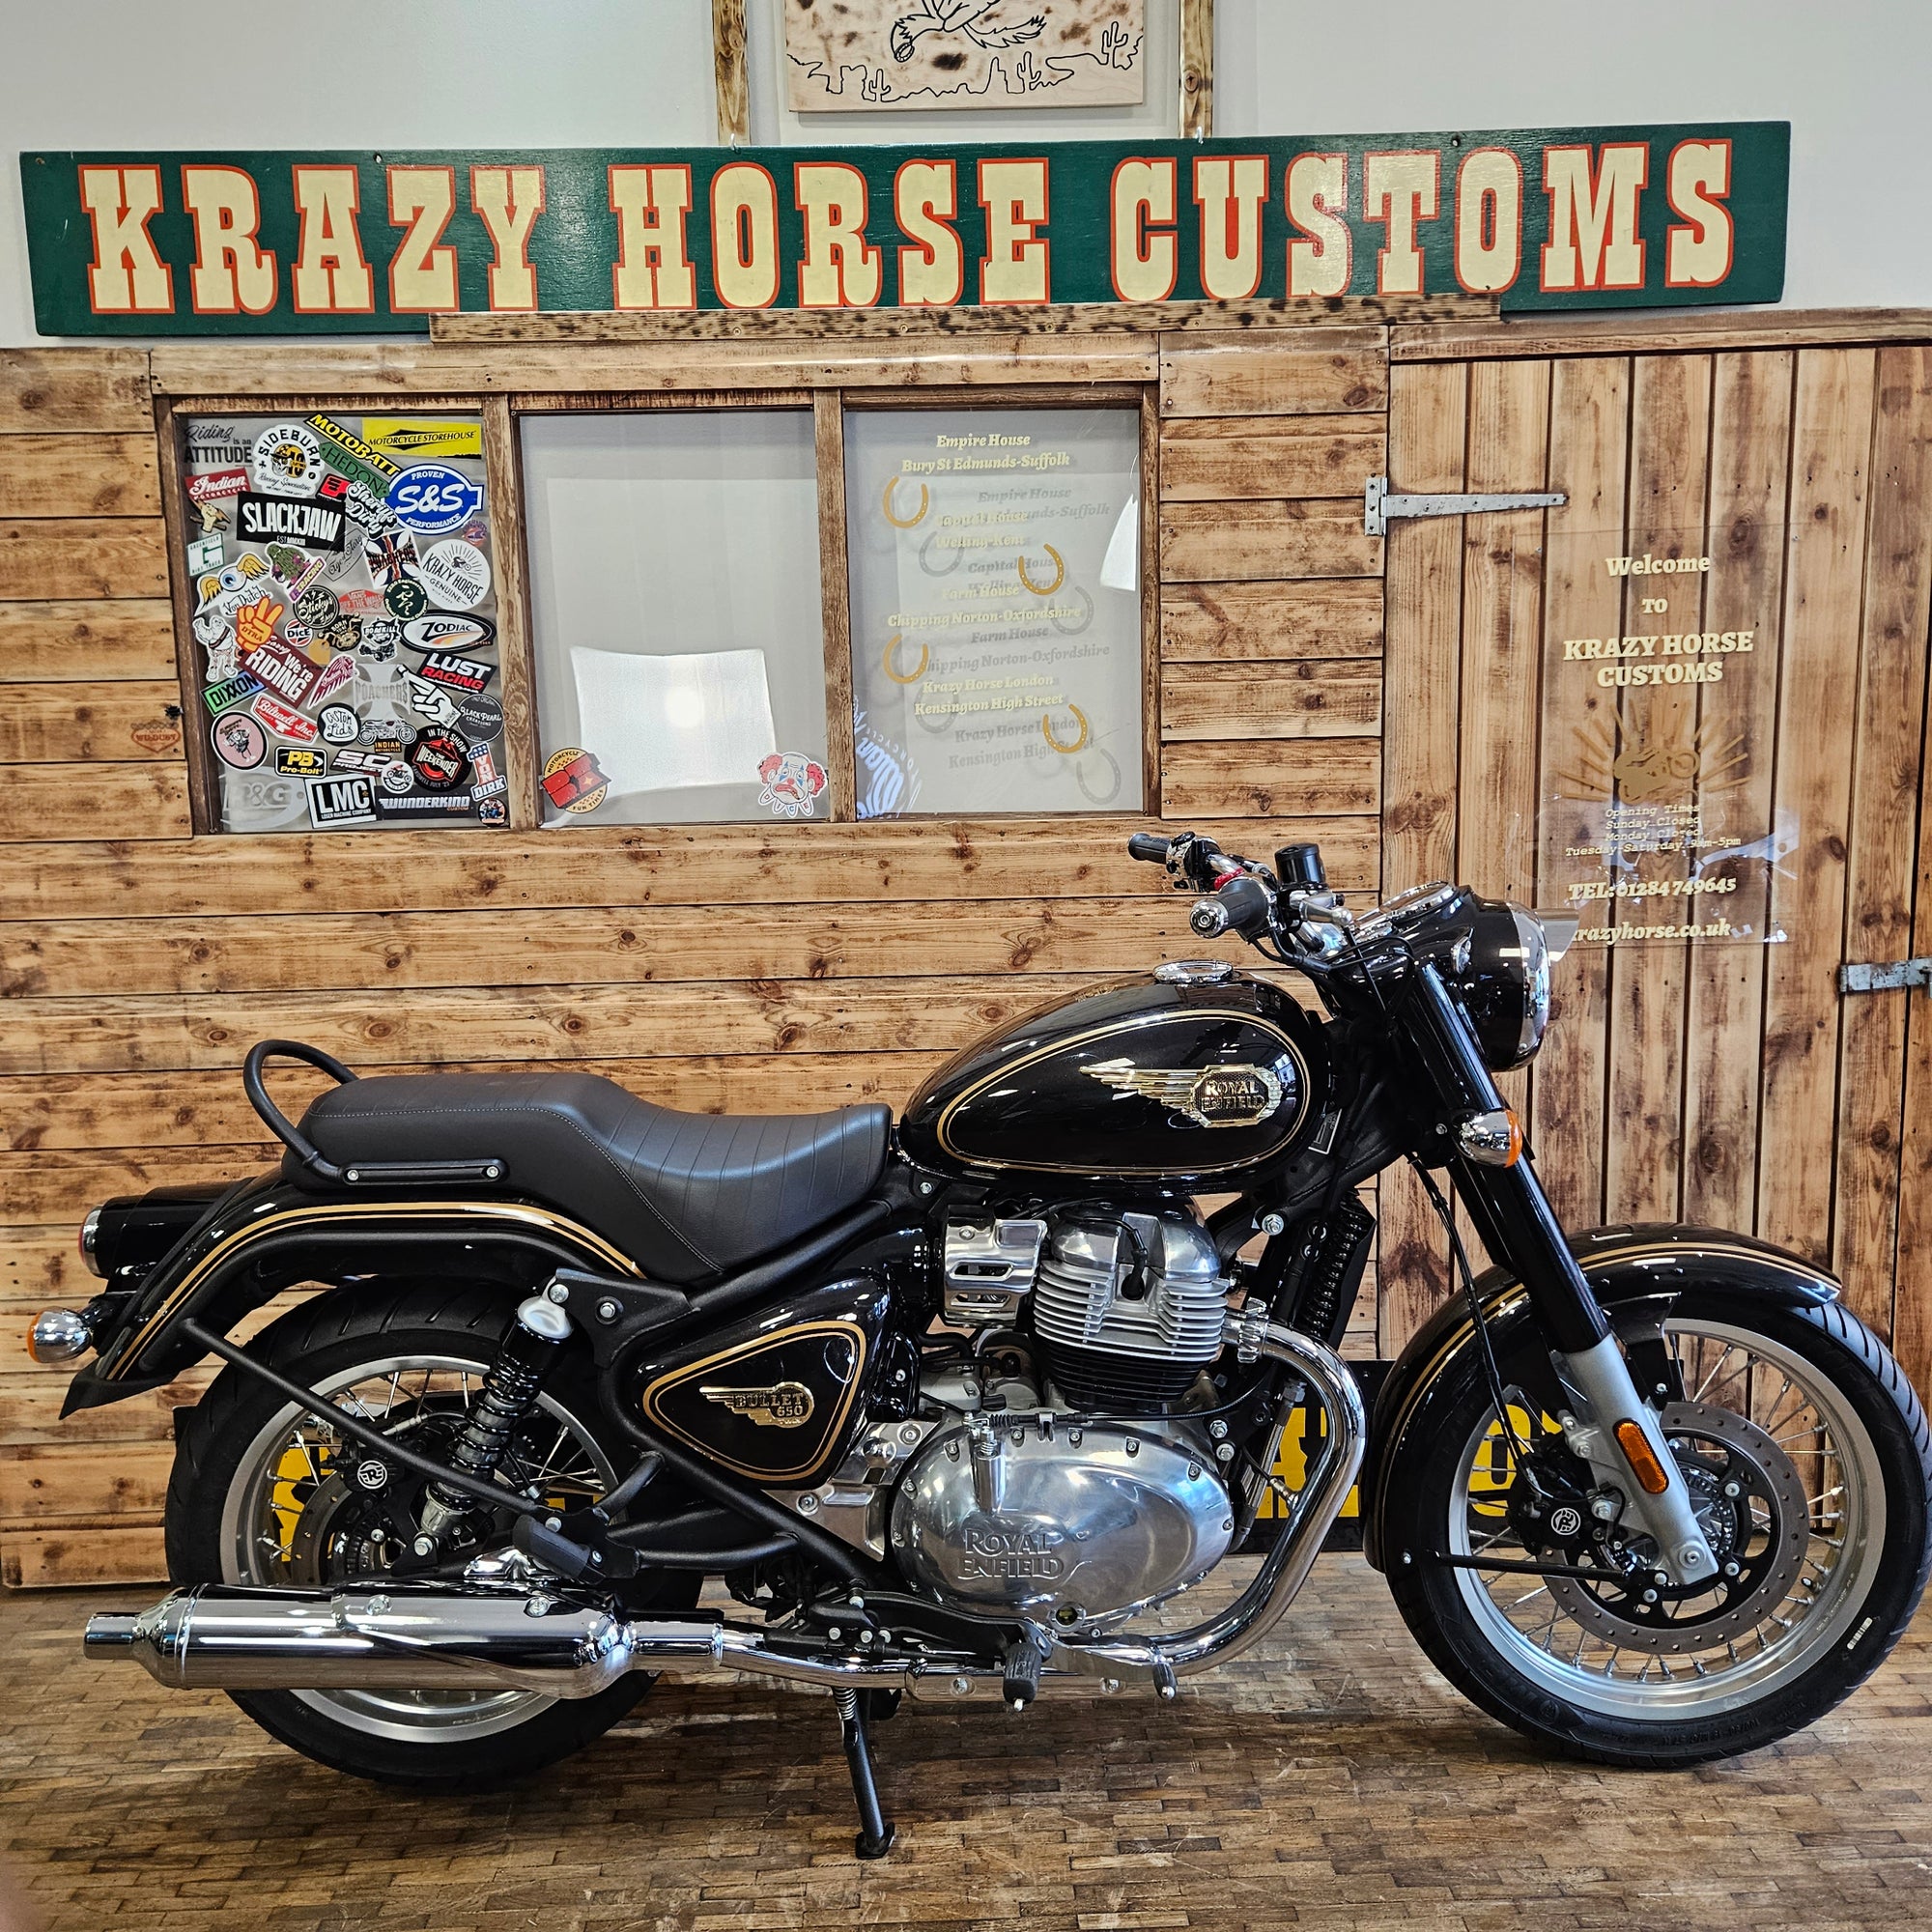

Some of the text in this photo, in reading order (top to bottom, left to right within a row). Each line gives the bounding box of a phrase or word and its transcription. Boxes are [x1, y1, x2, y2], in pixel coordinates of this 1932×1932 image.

[78, 138, 1734, 314] KRAZY HORSE CUSTOMS
[185, 423, 235, 442] Riding
[368, 431, 475, 446] MOTORCYCLE STOREHOUSE
[936, 433, 1031, 450] Empire House
[184, 446, 253, 463] ATTITUDE
[258, 428, 321, 467] SIDEBURN
[309, 413, 401, 476] MOTOBATT
[325, 447, 384, 495] HEDON
[901, 451, 1070, 475] Bury St Edmunds-Suffolk
[189, 475, 248, 496] Indian
[411, 470, 445, 481] PROVEN
[395, 483, 466, 514] S&S
[242, 501, 341, 542] SLACKJAW
[406, 513, 462, 528] PERFORMANCE
[1605, 554, 1711, 577] Welcome
[422, 553, 454, 583] KRAZY
[452, 574, 484, 605] HORSE
[429, 578, 463, 604] GENUINE
[979, 585, 1020, 598] House
[1642, 598, 1668, 614] TO
[888, 607, 1082, 629] Chipping Norton-Oxfordshire
[422, 621, 472, 642] ZODIAC
[1563, 630, 1754, 661] KRAZY HORSE
[245, 646, 308, 701] RIDING
[285, 652, 314, 683] We're
[427, 652, 492, 679] LUST
[1597, 661, 1724, 688] CUSTOMS
[420, 667, 485, 690] RACING
[922, 675, 1054, 696] Krazy Horse London
[209, 674, 258, 707] DIXXON
[355, 680, 409, 704] POACHERS
[257, 699, 296, 726] Biltwell
[460, 705, 481, 718] BLACK
[480, 712, 502, 722] PEARL
[914, 694, 1065, 716] Kensington High Street
[427, 728, 436, 737] IN
[437, 727, 450, 738] THE
[449, 733, 468, 753] SHOW
[287, 751, 315, 766] PB
[334, 750, 391, 769] SC
[416, 745, 459, 779] WEEKENDER
[475, 755, 493, 783] VON
[547, 751, 580, 774] MOTORCYCLE
[279, 766, 320, 775] Pro-Bolt
[316, 781, 370, 813] LMC
[473, 779, 505, 799] DIRK
[1605, 804, 1700, 819] Opening Times
[1605, 816, 1700, 831] Sunday Closed
[1605, 829, 1700, 842] Monday Closed
[1690, 837, 1742, 849] 9am-5pm
[1569, 876, 1737, 901] TEL: 01284 749645
[1206, 1080, 1259, 1096] ROYAL
[1201, 1095, 1266, 1112] ENFIELD
[735, 1392, 804, 1407] BULLET
[777, 1406, 804, 1417] 650
[964, 1528, 1052, 1557] ROYAL
[957, 1557, 1065, 1580] ENFIELD
